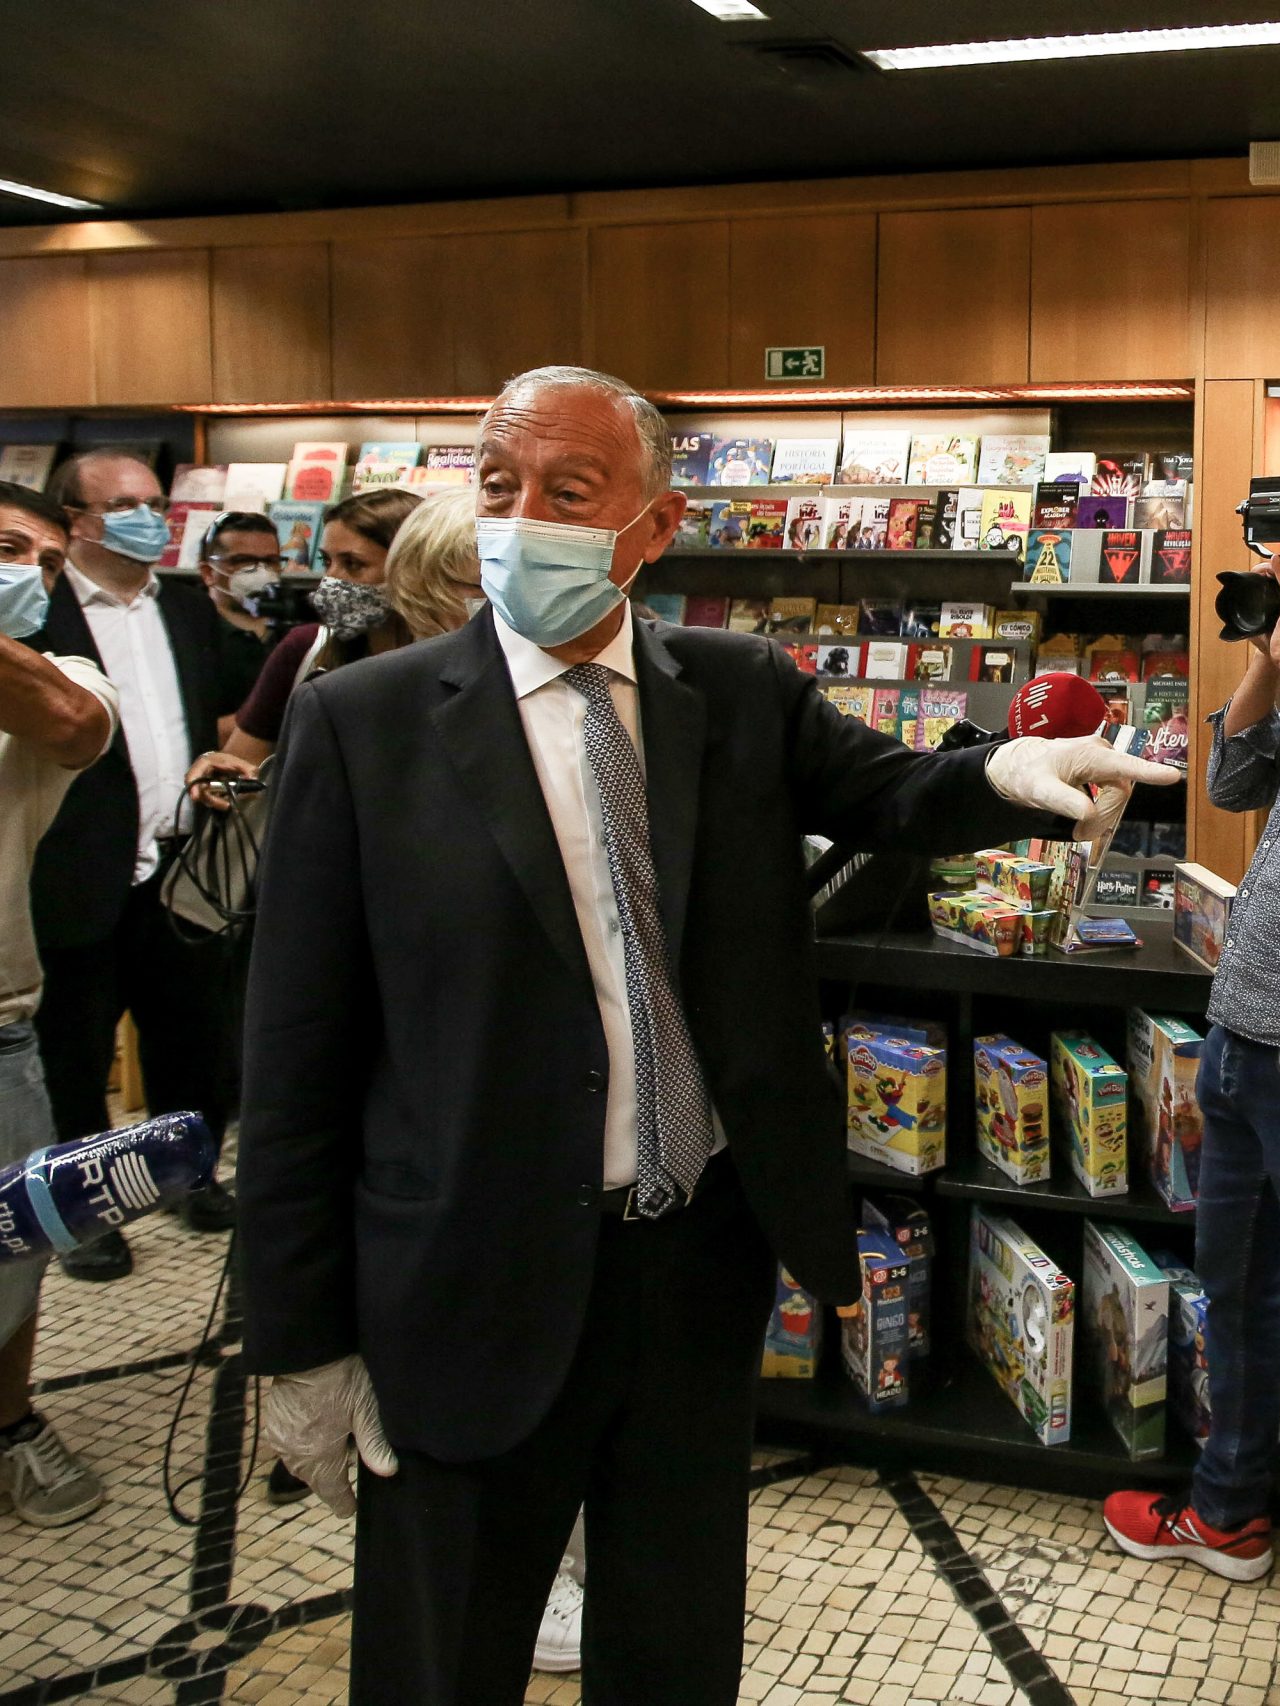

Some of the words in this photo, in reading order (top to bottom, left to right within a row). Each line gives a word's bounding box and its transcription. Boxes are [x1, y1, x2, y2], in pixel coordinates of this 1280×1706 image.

[1040, 551, 1055, 566] 22
[1014, 691, 1025, 738] ANTENA
[1097, 881, 1115, 893] Harry
[78, 1159, 124, 1225] RTP
[891, 1267, 907, 1279] 3-6
[877, 1313, 905, 1331] BINGO
